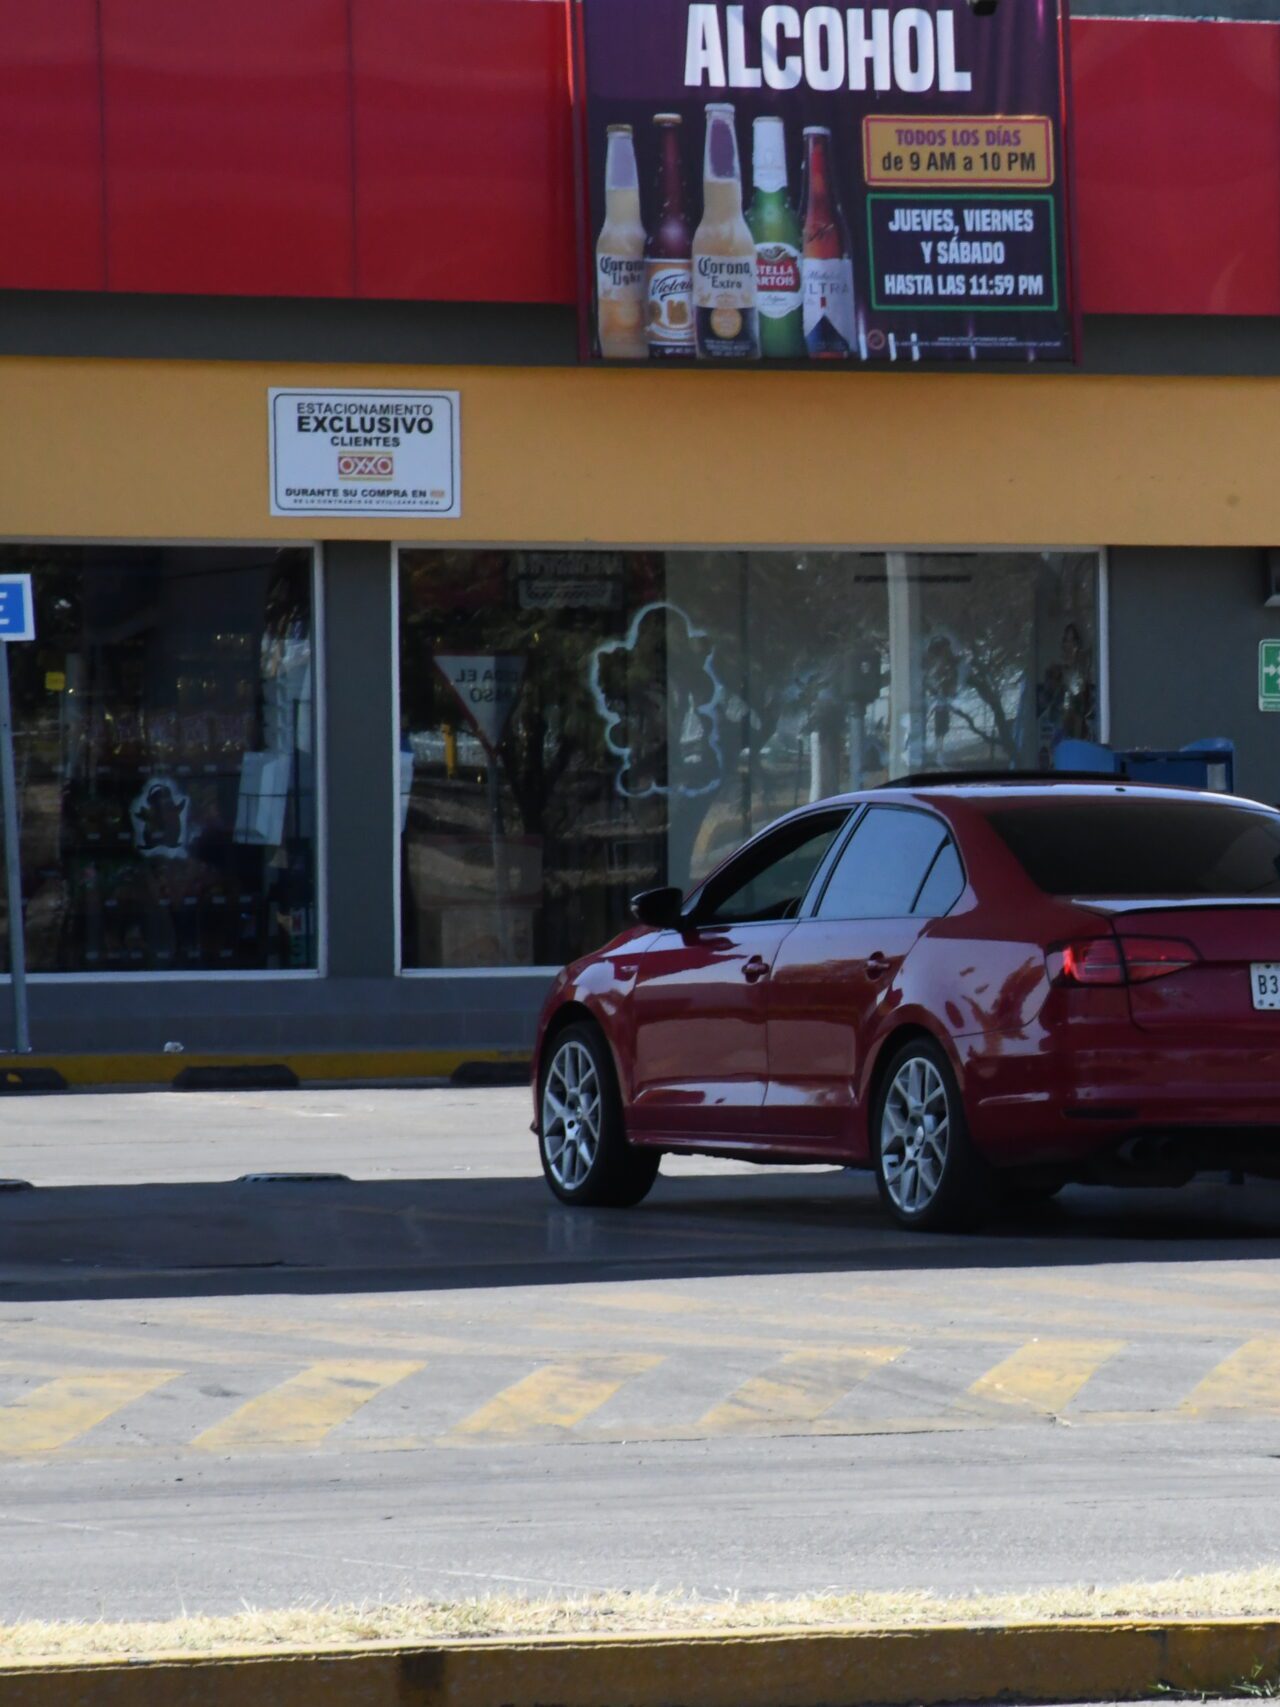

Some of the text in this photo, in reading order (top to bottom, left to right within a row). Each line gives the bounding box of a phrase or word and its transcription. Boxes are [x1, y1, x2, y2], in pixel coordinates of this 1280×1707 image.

[684, 3, 972, 92] ALCOHOL
[895, 126, 1021, 146] TODOS LOS DÍAS
[882, 152, 1035, 171] de 9 AM a 10 PM
[888, 209, 1034, 234] JUEVES, VIERNES
[921, 237, 1005, 264] Y SÁBADO
[884, 274, 1043, 295] HASTA LAS 11:59 PM
[297, 402, 433, 416] ESTACIONAMIENTO
[297, 416, 433, 434] EXCLUSIVO
[330, 436, 400, 447] CLIENTES
[339, 456, 393, 475] OXXO
[285, 488, 339, 497] DURANTE
[342, 488, 357, 497] SU
[361, 488, 408, 498] COMPRA
[412, 489, 426, 498] EN
